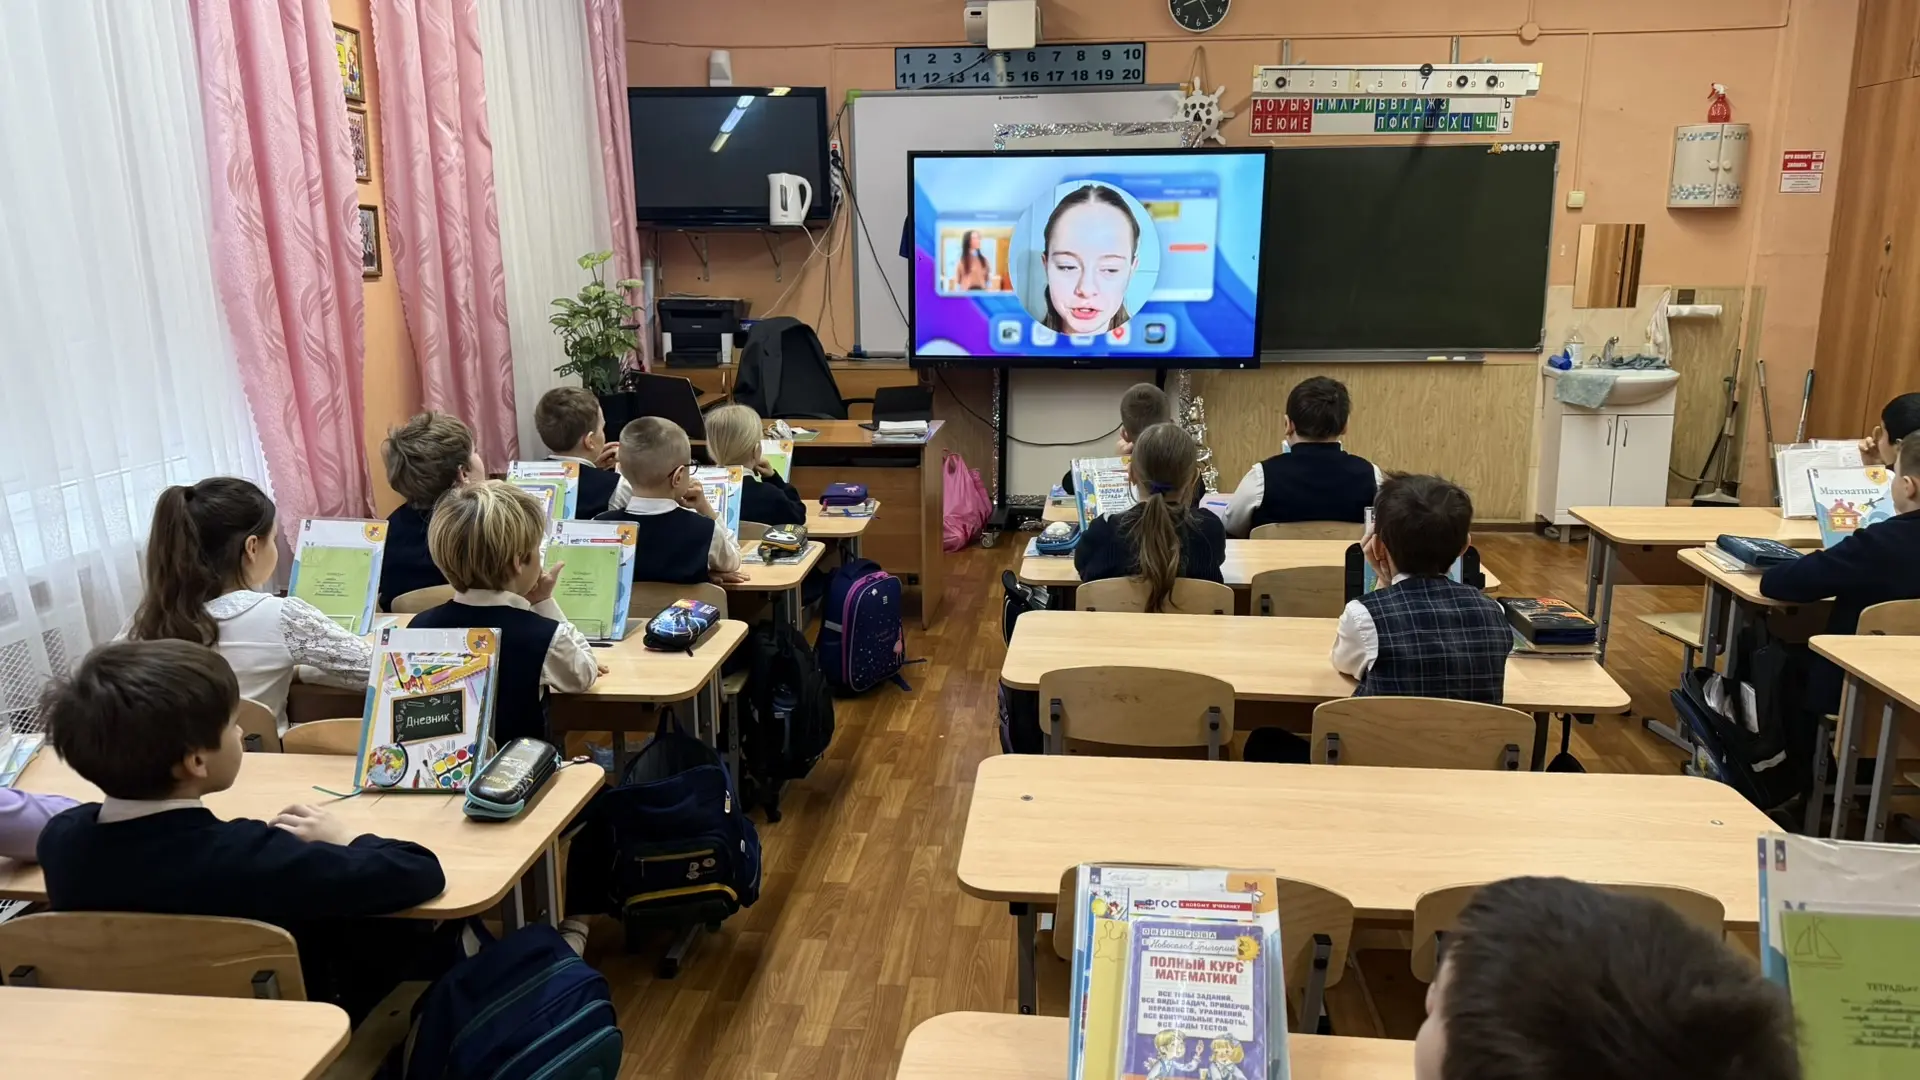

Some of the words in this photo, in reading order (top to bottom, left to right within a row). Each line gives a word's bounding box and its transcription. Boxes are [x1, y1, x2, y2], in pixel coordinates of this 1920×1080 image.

[1176, 8, 1180, 16] 8
[1184, 15, 1188, 23] 7
[1196, 18, 1201, 26] 6
[904, 53, 910, 64] 1
[928, 53, 936, 64] 2
[953, 52, 962, 64] 3
[977, 52, 986, 63] 4
[1004, 52, 1012, 62] 5
[1027, 51, 1036, 62] 6
[1052, 51, 1062, 62] 7
[1076, 50, 1086, 61] 8
[1102, 49, 1111, 60] 9
[1123, 48, 1141, 60] 10
[900, 72, 916, 83] 11
[923, 72, 940, 83] 12
[948, 72, 965, 83] 13
[972, 72, 990, 83] 14
[997, 71, 1015, 82] 15
[1021, 71, 1039, 82] 16
[1046, 70, 1064, 82] 17
[1070, 70, 1088, 81] 18
[1096, 69, 1114, 80] 19
[1122, 68, 1141, 80] 20
[1421, 77, 1429, 90] 7
[1820, 486, 1879, 495] Математика
[406, 713, 450, 728] Дневник
[1150, 956, 1206, 970] ПОЛНЫЙ
[1210, 960, 1244, 973] КУРС
[1155, 969, 1237, 985] МАТЕМАТИКИ
